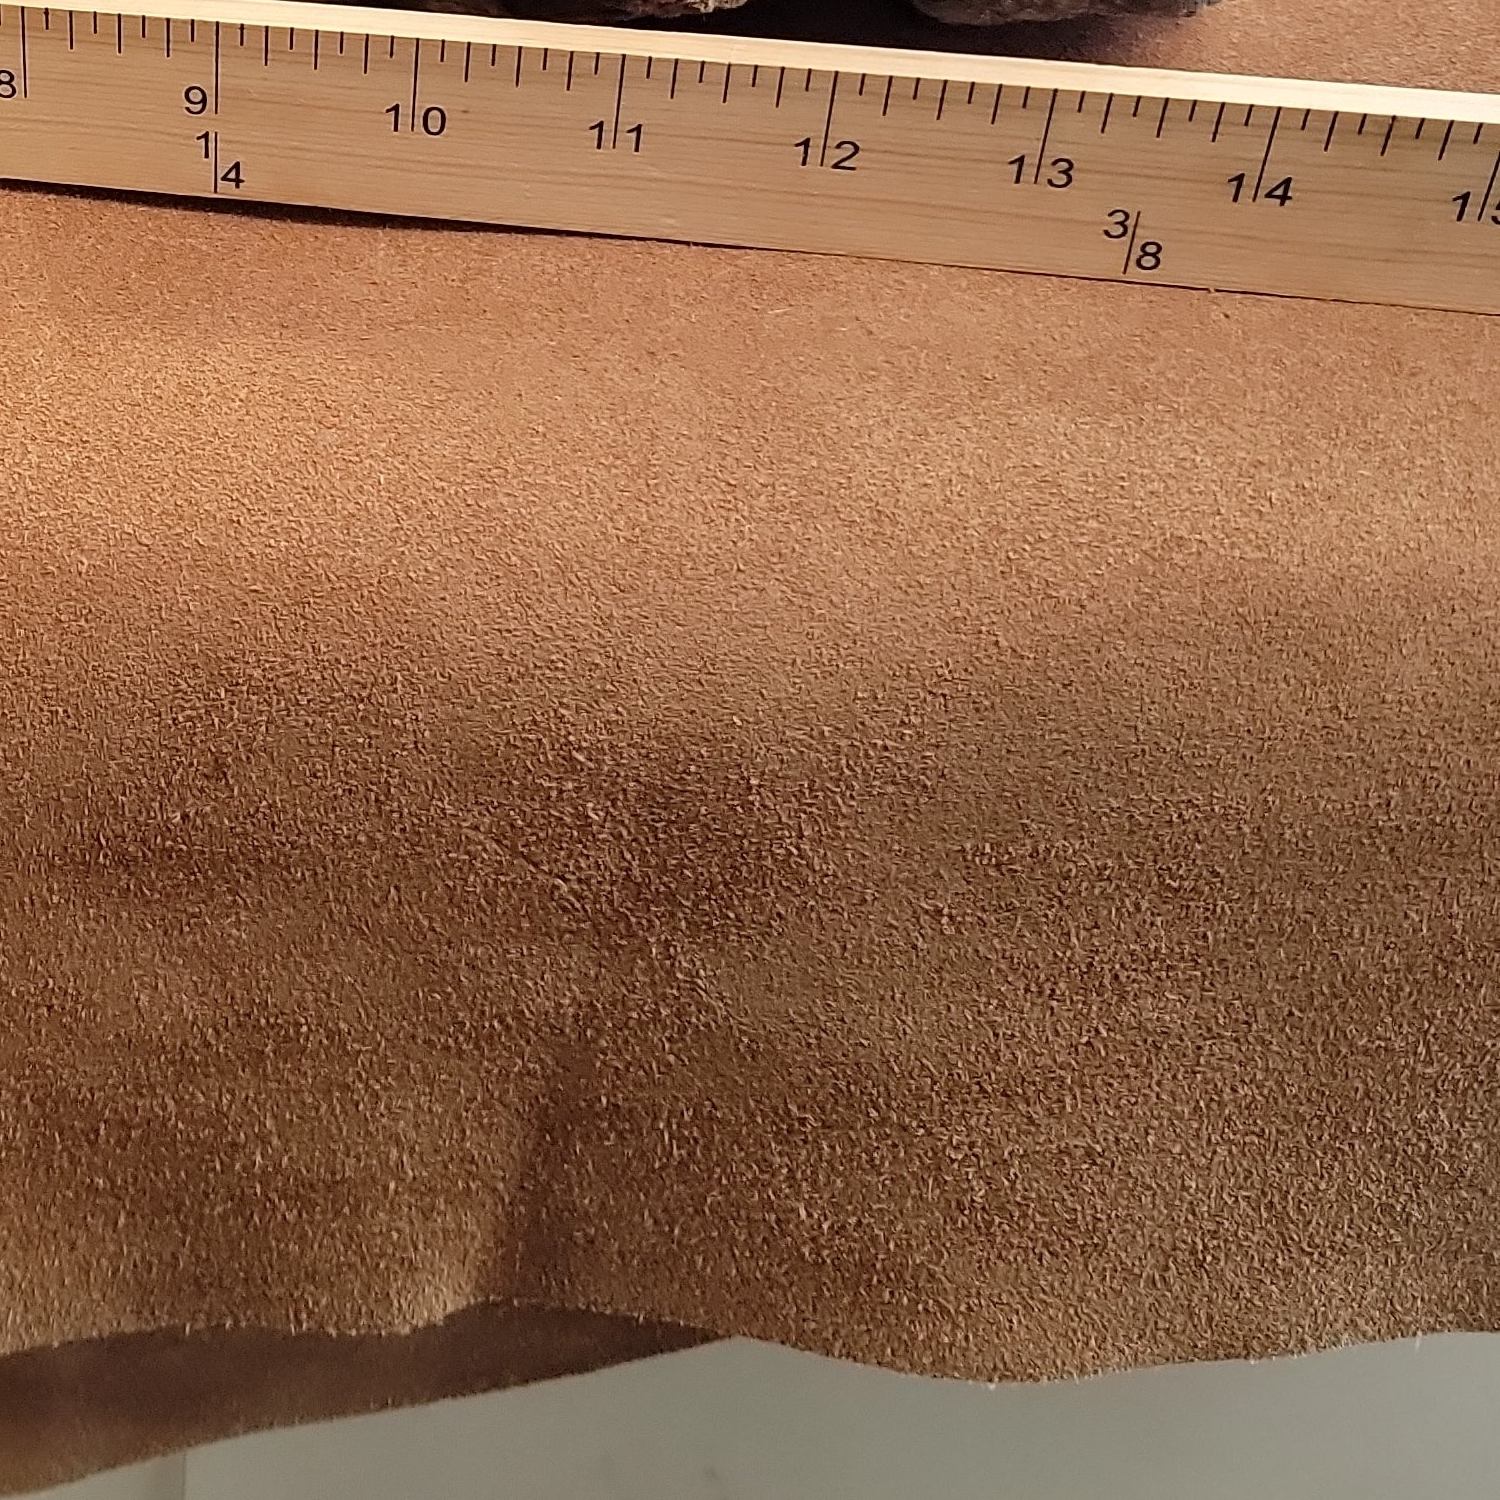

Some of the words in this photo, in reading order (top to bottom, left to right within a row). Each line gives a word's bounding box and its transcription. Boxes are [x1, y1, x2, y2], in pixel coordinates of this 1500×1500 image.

[183, 85, 208, 116] 9
[385, 103, 447, 137] 10
[588, 120, 645, 156] 11
[794, 137, 861, 173] 12
[1007, 154, 1075, 189] 13
[1227, 172, 1294, 207] 14
